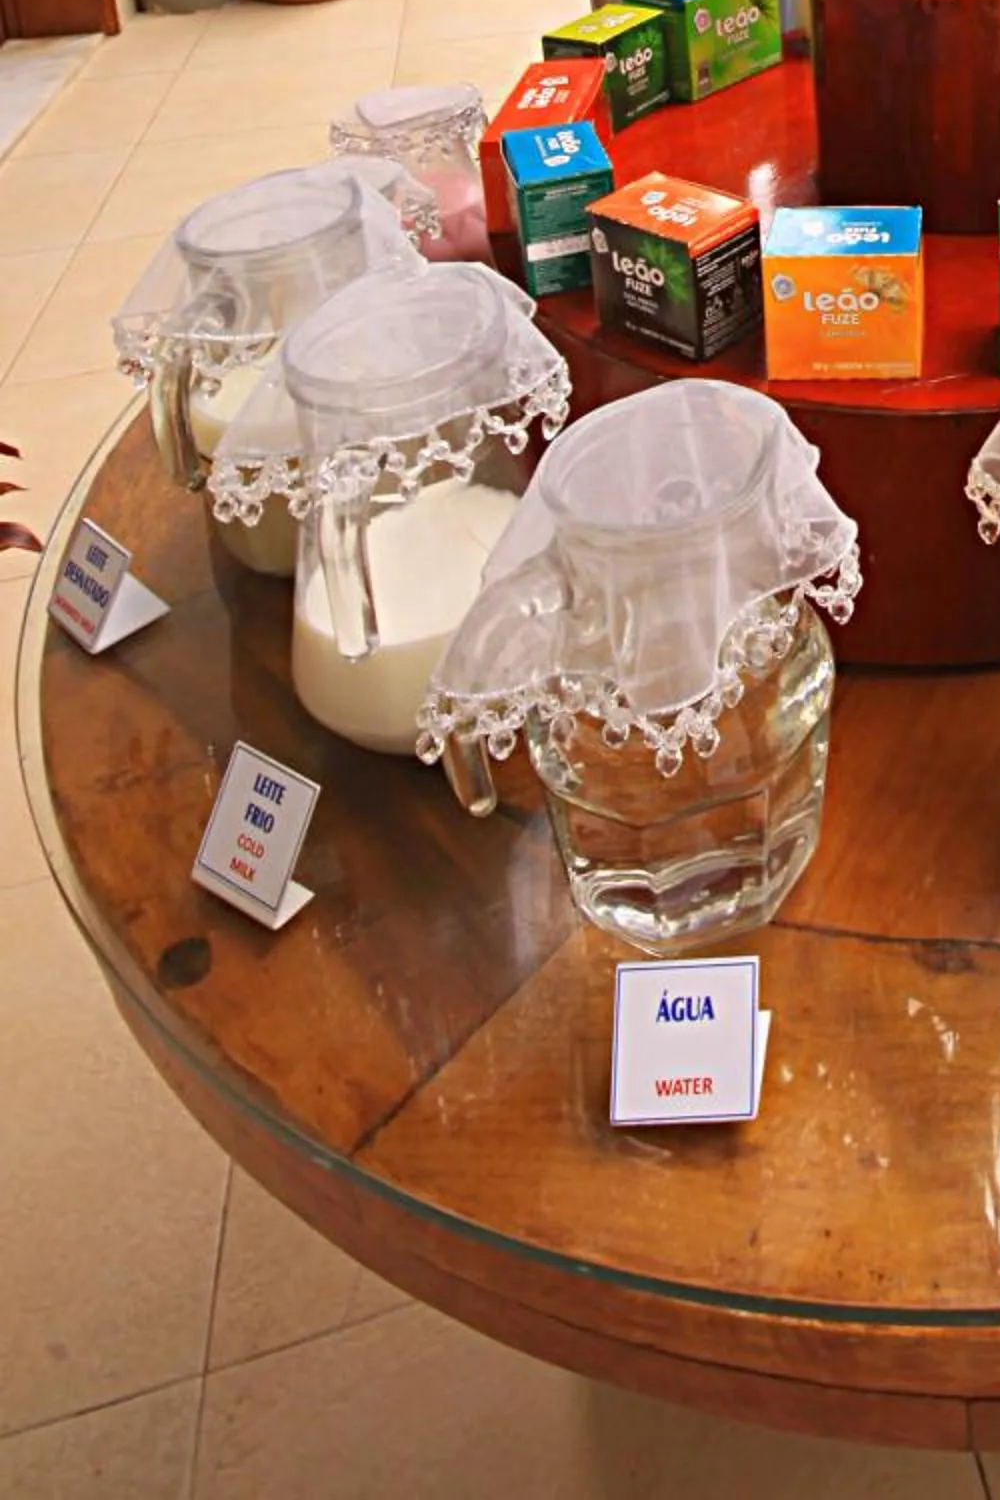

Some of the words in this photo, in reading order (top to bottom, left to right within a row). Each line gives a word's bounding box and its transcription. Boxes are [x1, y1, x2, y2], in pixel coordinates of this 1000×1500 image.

[612, 251, 665, 288] leão
[803, 287, 880, 312] leão
[821, 313, 861, 326] FUZE
[253, 772, 287, 806] LEITE
[244, 803, 275, 834] FRIO
[237, 833, 265, 858] COLD
[230, 857, 256, 882] MILK
[656, 989, 715, 1023] ÁGUA
[655, 1077, 713, 1097] WATER
